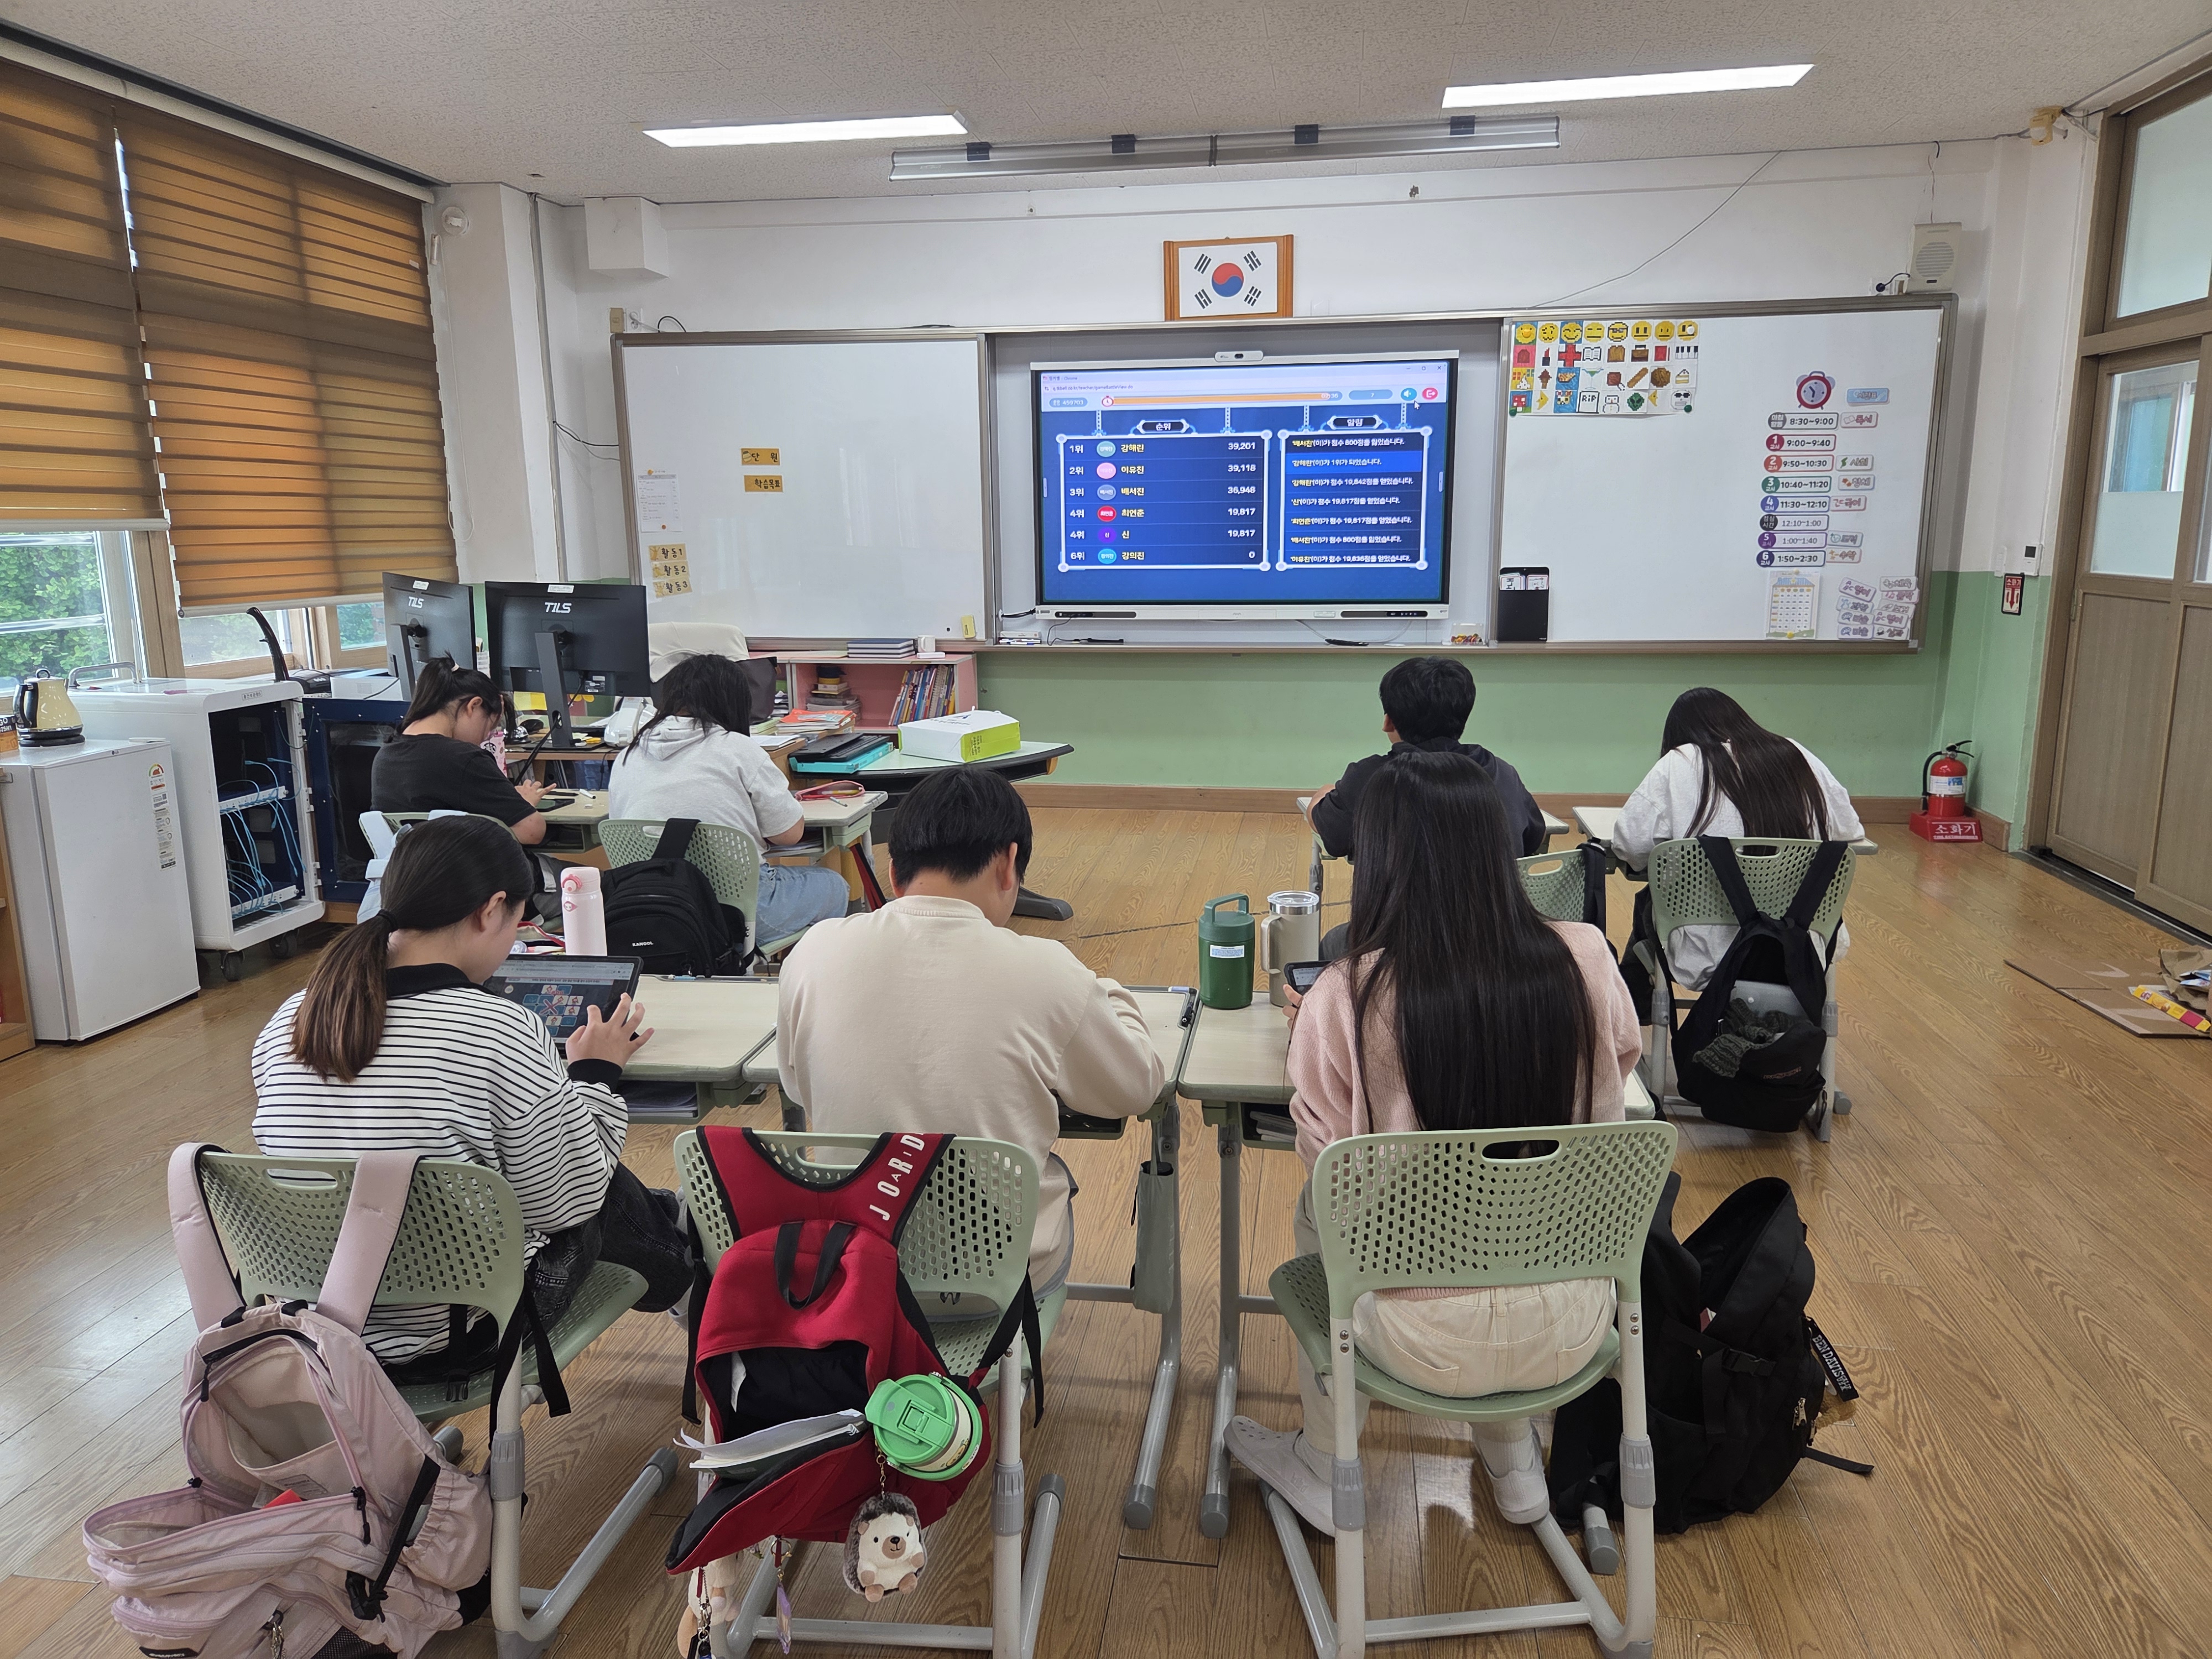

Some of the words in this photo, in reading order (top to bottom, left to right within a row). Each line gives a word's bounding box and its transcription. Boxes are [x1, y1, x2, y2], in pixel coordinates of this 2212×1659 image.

[1855, 414, 1873, 425] 독서
[1155, 422, 1171, 431] 순위
[1772, 435, 1778, 444] 1
[1069, 445, 1083, 453] 1위
[1120, 444, 1144, 452] 강해린
[1228, 442, 1256, 451] 39,201
[1770, 456, 1776, 465] 2
[1069, 466, 1084, 475] 2위
[1120, 466, 1144, 474] 이유진
[1228, 464, 1256, 473] 39,118
[754, 478, 781, 490] 학습목표
[1767, 478, 1774, 486] 3
[1070, 488, 1084, 497] 3위
[1120, 488, 1145, 496] 배서진
[1228, 486, 1256, 494] 36,948
[1766, 497, 1773, 506] 4
[1845, 498, 1861, 508] 국어
[1070, 509, 1084, 518] 4위
[1121, 509, 1145, 518] 최연준
[1228, 508, 1256, 516] 19,817
[1070, 530, 1085, 539] 4위
[1121, 530, 1130, 539] 신
[1228, 529, 1256, 538] 19,817
[1070, 552, 1085, 560] 6위
[1121, 552, 1145, 560] 강의진
[1762, 552, 1769, 560] 6
[1854, 585, 1871, 597] 영어
[408, 596, 424, 608] TILS
[545, 602, 572, 613] TILS
[1887, 614, 1904, 624] 영어
[1934, 823, 1976, 836] 소화기
[1812, 1334, 1830, 1353] BEN
[1822, 1351, 1844, 1378] DAVIS
